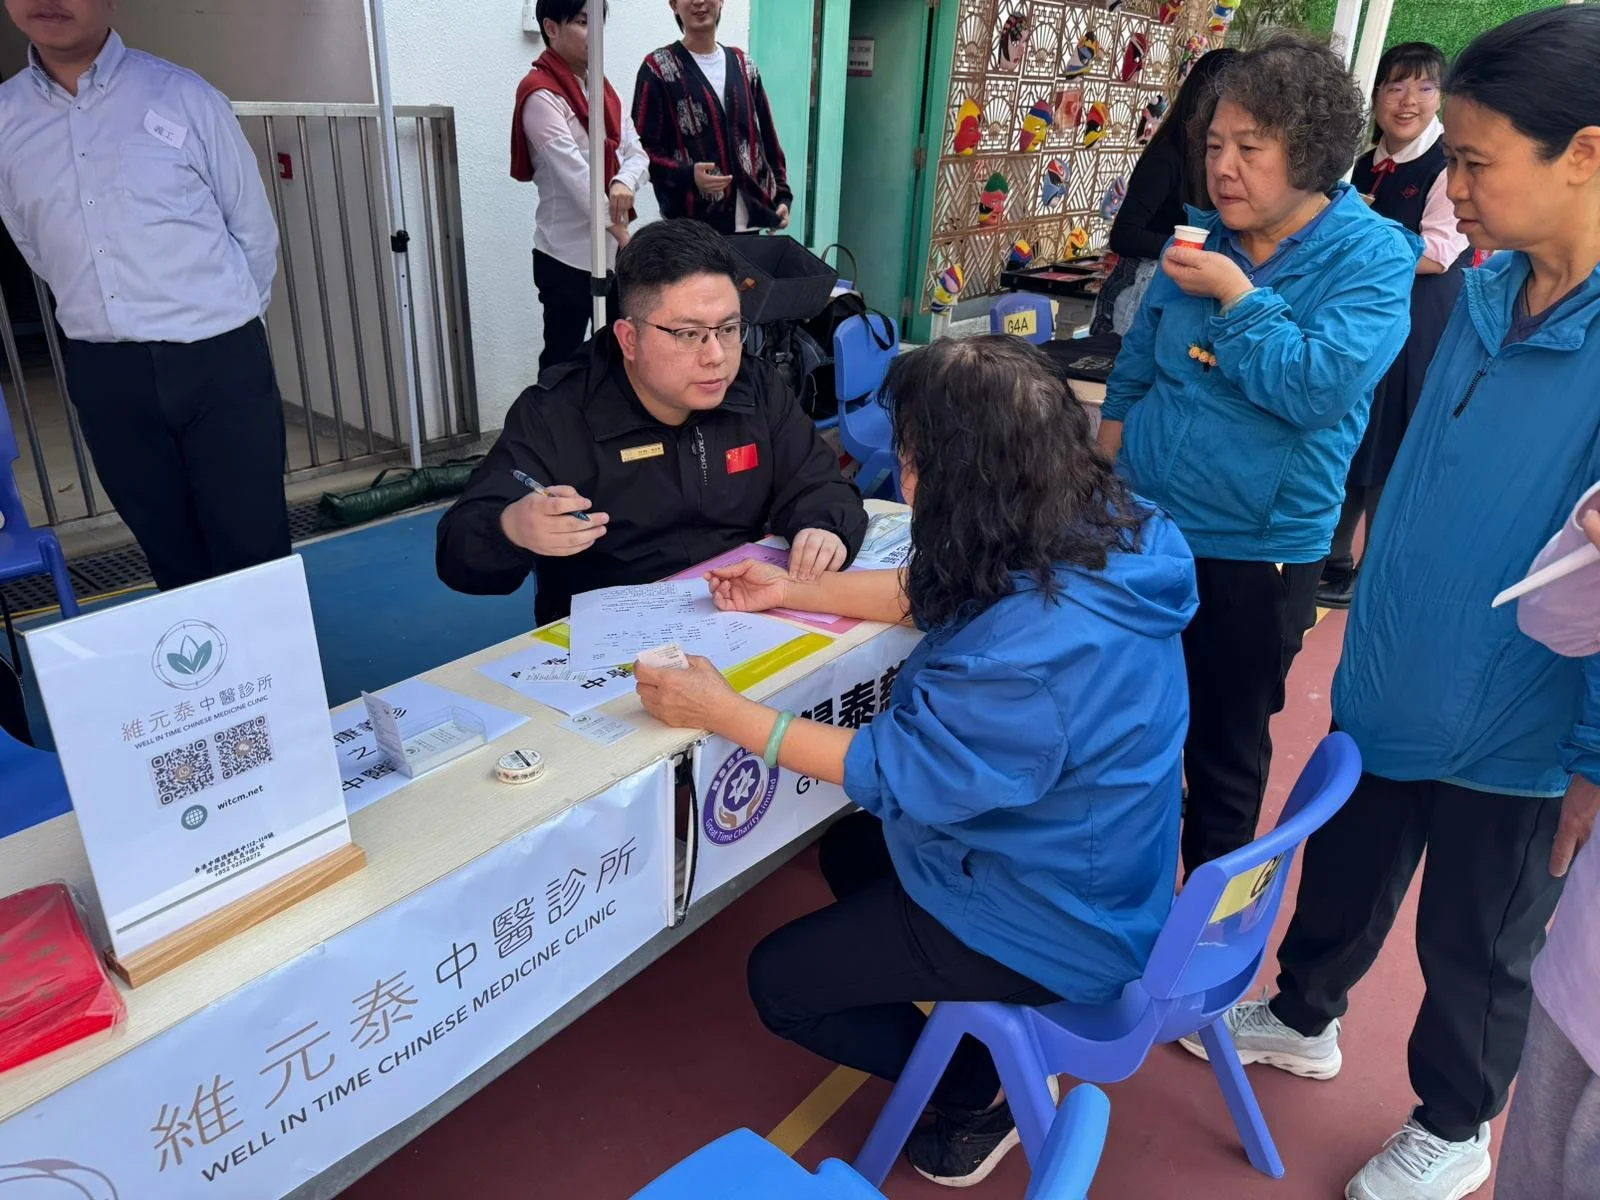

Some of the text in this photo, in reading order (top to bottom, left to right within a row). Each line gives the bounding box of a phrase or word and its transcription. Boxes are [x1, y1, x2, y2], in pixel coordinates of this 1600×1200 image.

[1008, 317, 1029, 334] G4A
[121, 674, 273, 742] 維元泰中醫診所
[134, 739, 157, 750] WELL
[164, 727, 182, 739] TIME
[183, 716, 213, 731] CHINESE
[213, 703, 247, 720] MEDICINE
[247, 695, 269, 707] CLINIC
[346, 746, 377, 761] 之
[217, 785, 264, 811] witcm.net
[705, 778, 777, 842] Great Time Charity Limited
[150, 836, 637, 1172] 維元泰中醫診所
[201, 899, 618, 1182] WELL IN TIME CHINESE MEDICINE CLINIC
